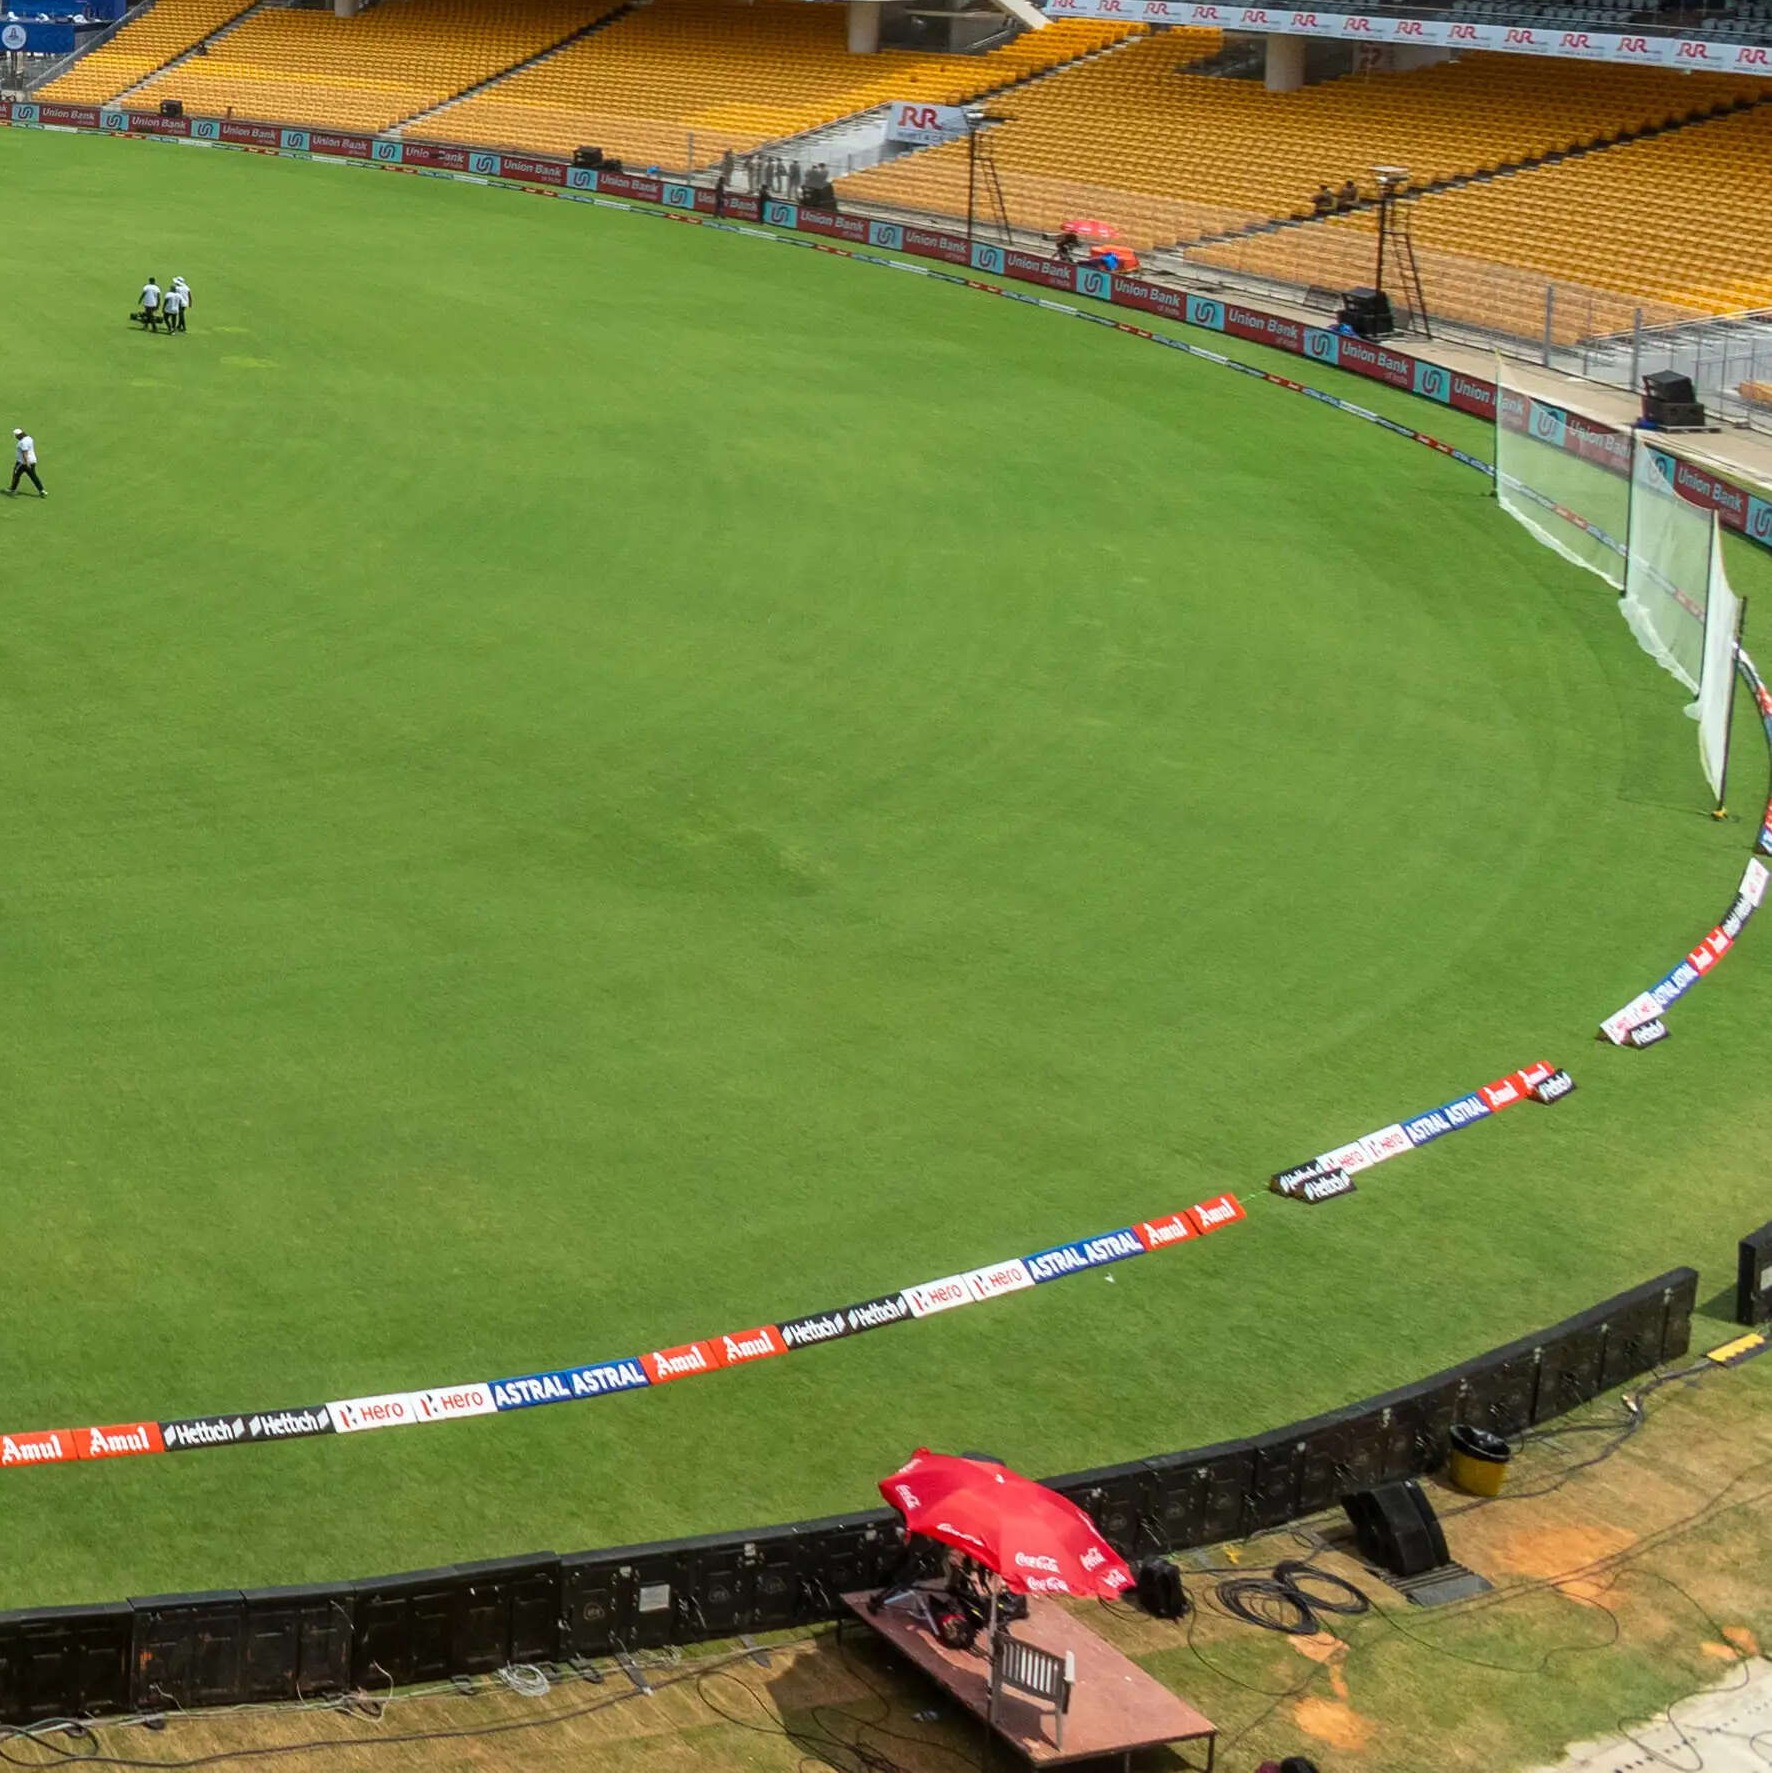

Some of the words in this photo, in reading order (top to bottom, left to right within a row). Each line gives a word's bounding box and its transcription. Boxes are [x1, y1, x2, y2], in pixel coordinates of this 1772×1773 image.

[42, 108, 67, 118] Union
[70, 111, 95, 120] Bank
[802, 209, 833, 226] Union
[835, 214, 865, 232] Bank
[1007, 254, 1038, 272] Union
[1041, 261, 1072, 279] Bank
[1114, 279, 1147, 298] Union
[1149, 288, 1181, 308] Bank
[1228, 308, 1265, 329] Union
[1268, 319, 1298, 339] Bank
[1342, 340, 1376, 363] Union
[1377, 352, 1408, 373] Bank
[1678, 468, 1711, 496] Union
[1714, 481, 1744, 511] Bank
[1197, 1197, 1236, 1228] Amul
[1146, 1217, 1188, 1247] Amul
[1084, 1231, 1142, 1264] ASTRAL
[988, 1266, 1022, 1287] Hero
[1029, 1246, 1085, 1280] ASTRAL
[928, 1284, 963, 1304] Hero
[855, 1299, 903, 1330] Hettich
[790, 1315, 838, 1346] Hettich
[723, 1330, 776, 1363] Amul
[653, 1345, 707, 1380] Amul
[494, 1376, 570, 1408] ASTRAL
[571, 1362, 646, 1397] ASTRAL
[361, 1401, 405, 1421] Hero
[441, 1390, 484, 1412] Hero
[175, 1418, 232, 1445] Hettich
[260, 1410, 317, 1437] Hettich
[0, 1434, 63, 1463] Amul
[89, 1426, 150, 1455] Amul
